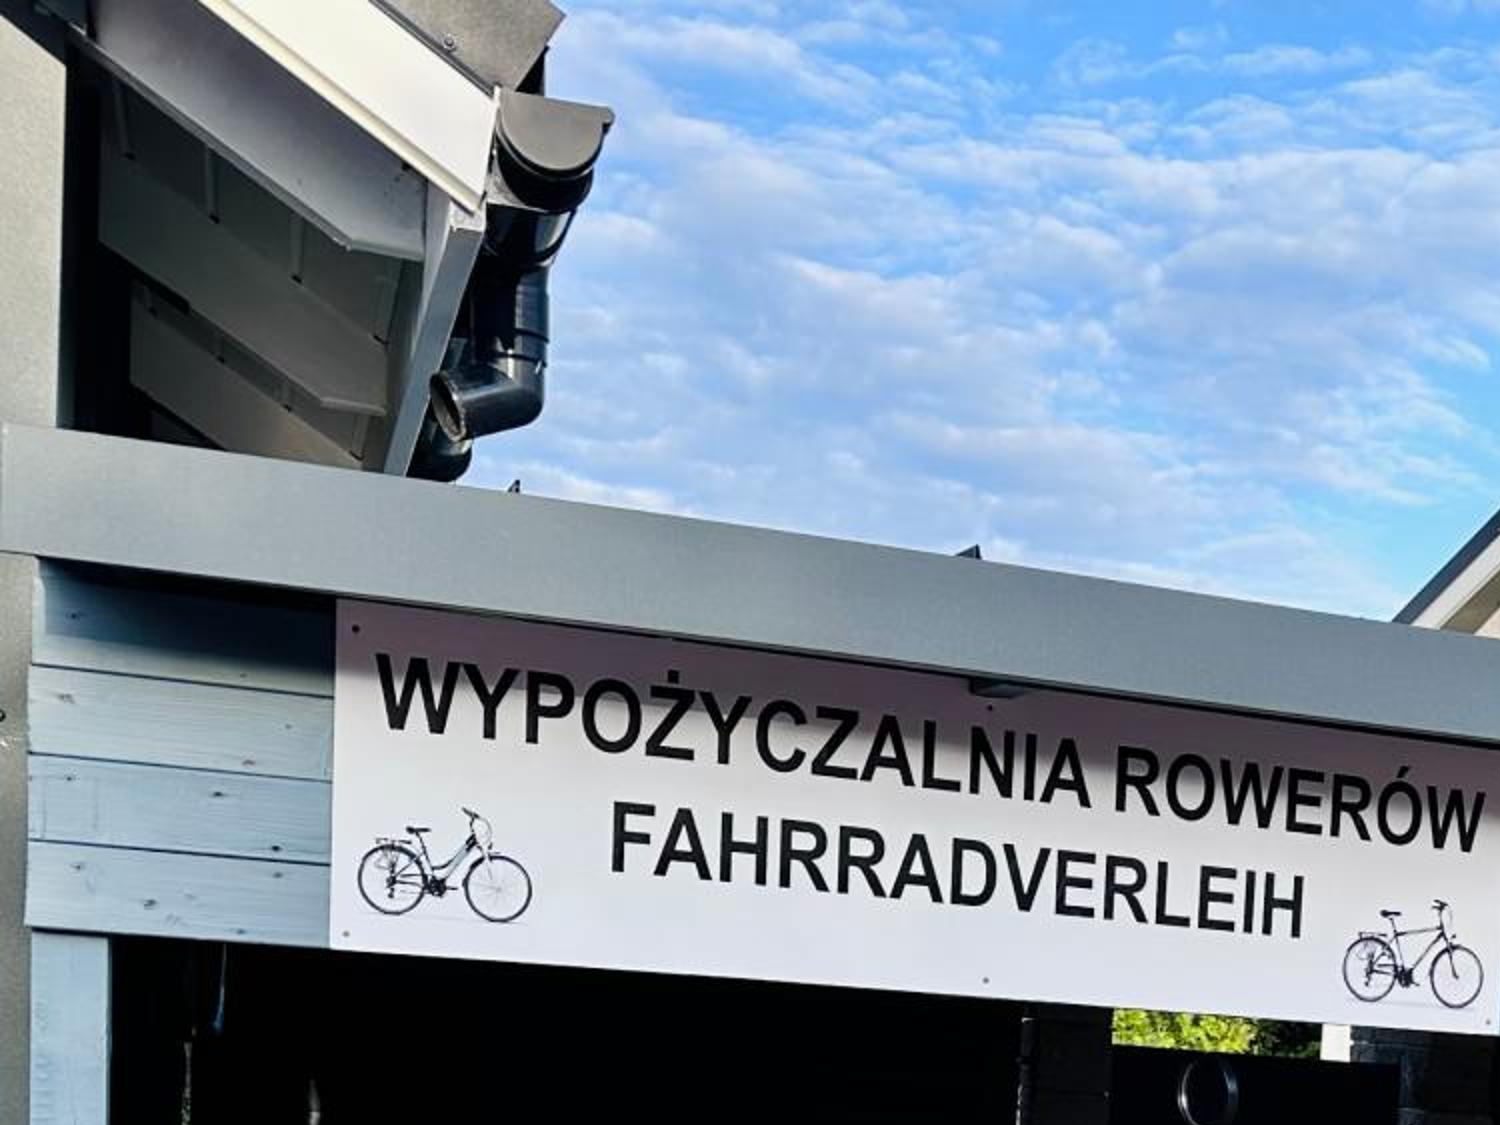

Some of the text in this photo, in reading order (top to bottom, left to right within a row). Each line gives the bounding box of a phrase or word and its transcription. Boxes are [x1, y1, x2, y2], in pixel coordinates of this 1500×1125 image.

[376, 652, 1486, 853] WYPOŻYCZALNIA ROWERÓW
[611, 801, 1304, 938] FAHRRADVERLEIH
